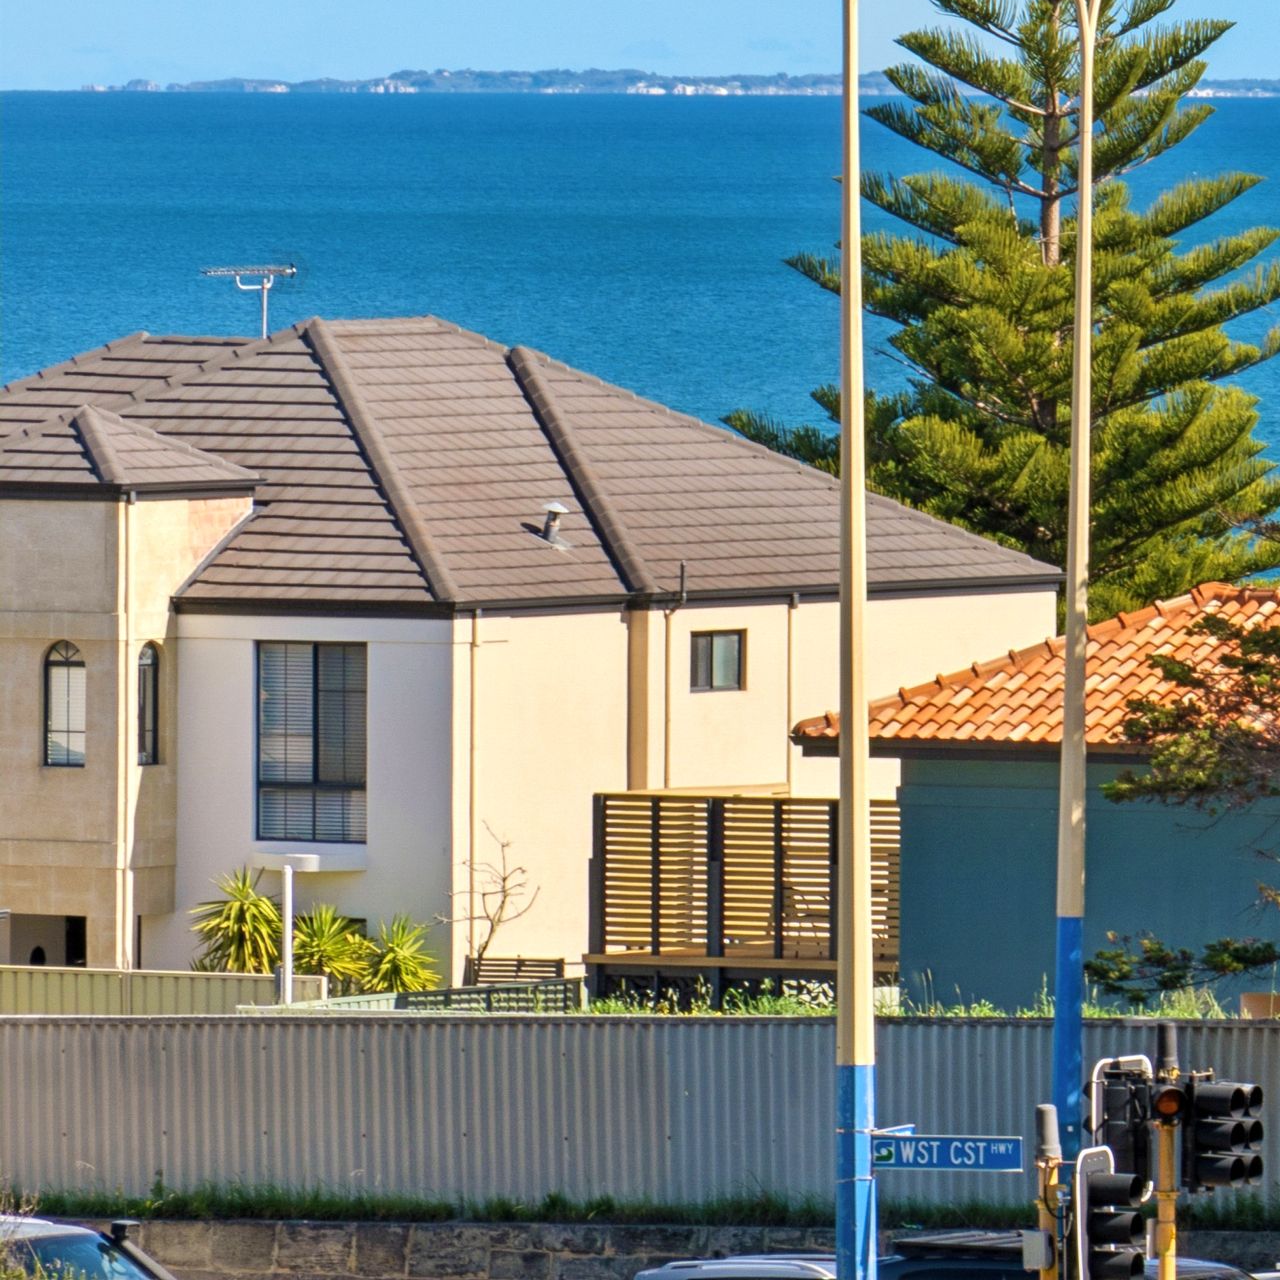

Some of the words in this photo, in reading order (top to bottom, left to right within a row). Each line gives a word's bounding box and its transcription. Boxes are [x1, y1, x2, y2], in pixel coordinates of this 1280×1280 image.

[900, 1140, 940, 1164] WST
[950, 1141, 987, 1165] CST
[991, 1142, 1013, 1154] HWY
